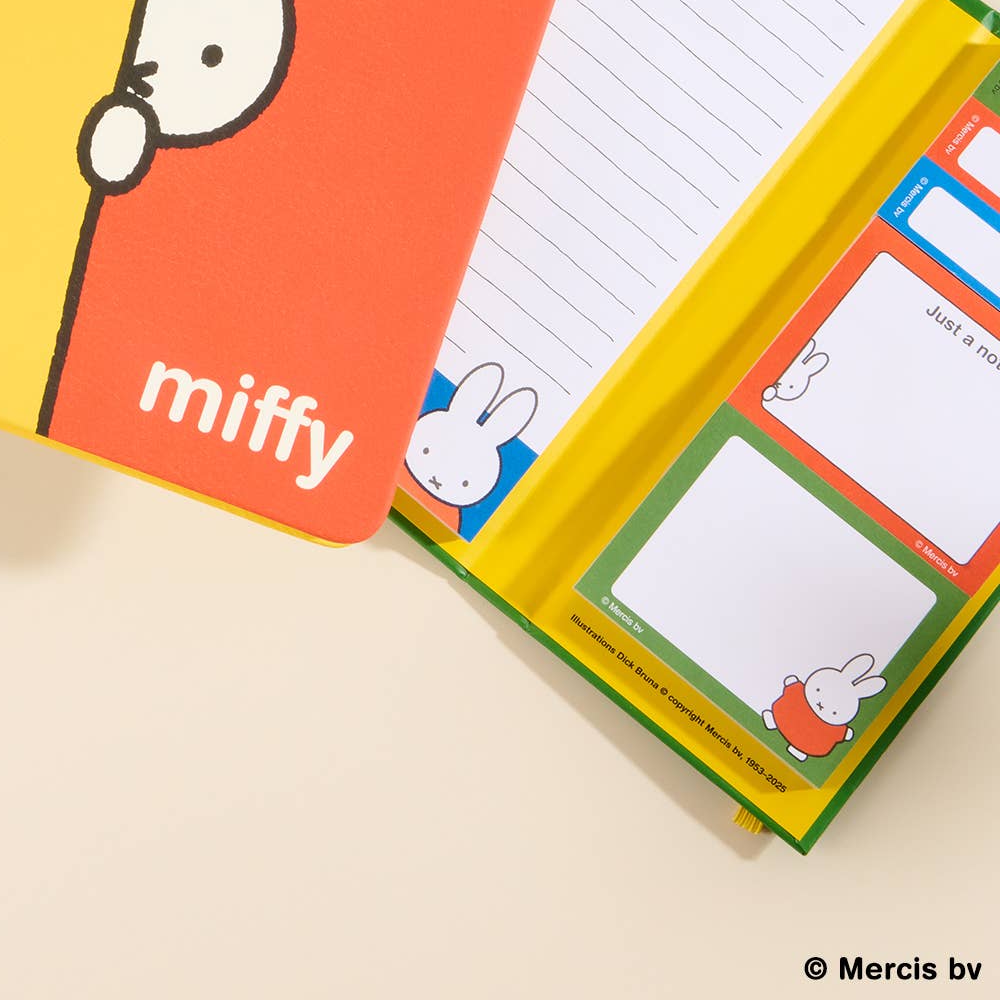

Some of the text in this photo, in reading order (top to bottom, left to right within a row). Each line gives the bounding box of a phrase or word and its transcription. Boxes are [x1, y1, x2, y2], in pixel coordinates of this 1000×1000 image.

[926, 305, 962, 336] Just
[962, 334, 975, 346] a
[139, 361, 354, 490] miffy
[922, 546, 948, 569] Mercis
[608, 602, 633, 626] Mercis
[633, 622, 644, 634] bv
[570, 614, 616, 654] Illustrations
[616, 651, 635, 669] Dick
[635, 666, 659, 689] Bruna
[668, 695, 706, 727] copyright
[705, 724, 732, 748] Mercis
[732, 746, 744, 760] bv,
